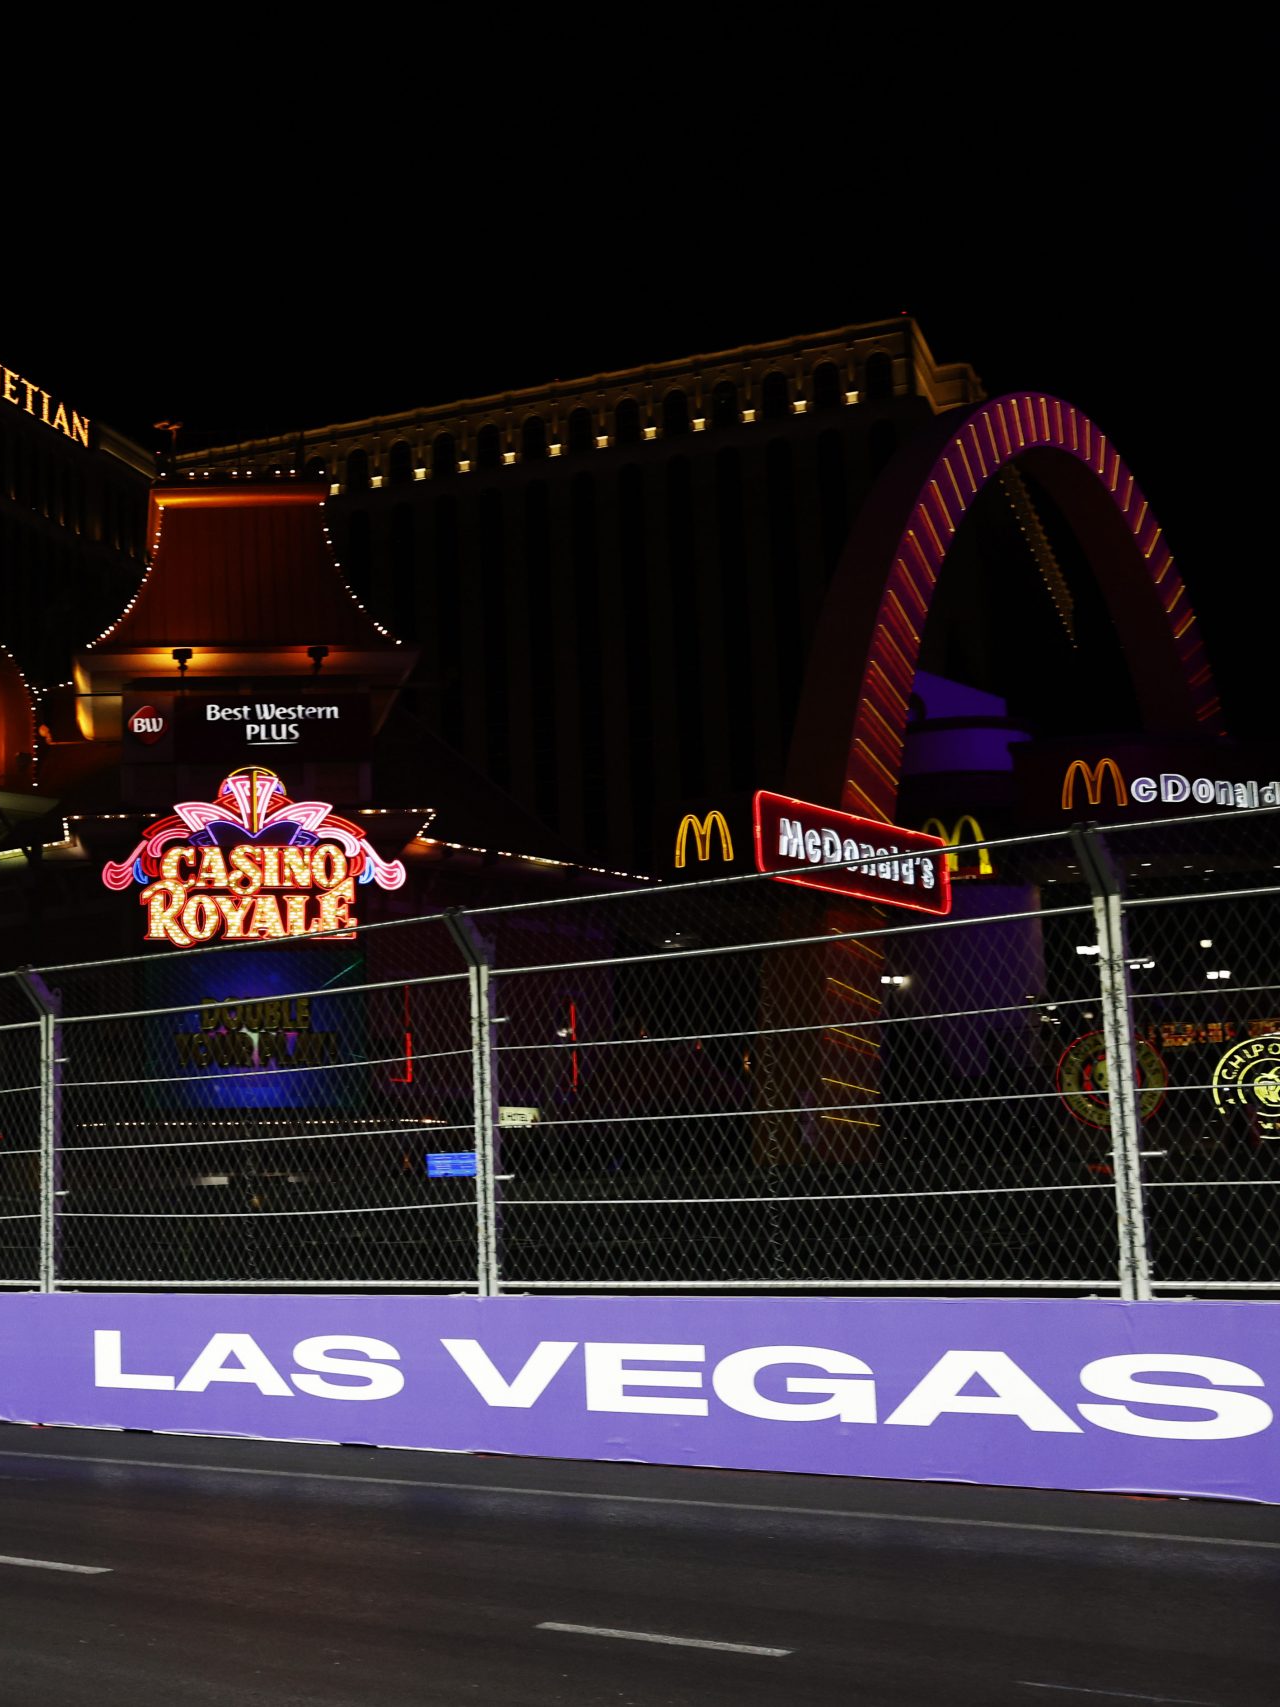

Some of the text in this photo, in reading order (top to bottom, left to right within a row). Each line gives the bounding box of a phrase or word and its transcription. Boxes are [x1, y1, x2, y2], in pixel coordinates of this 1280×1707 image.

[133, 717, 163, 733] BW
[206, 703, 339, 721] Best Western
[246, 723, 300, 741] PLUS
[159, 843, 348, 896] CASINO
[778, 817, 935, 890] McDonald's
[140, 877, 358, 948] ROYALE
[201, 997, 311, 1031] DOUBLE
[94, 1330, 1274, 1441] LAS VEGAS
